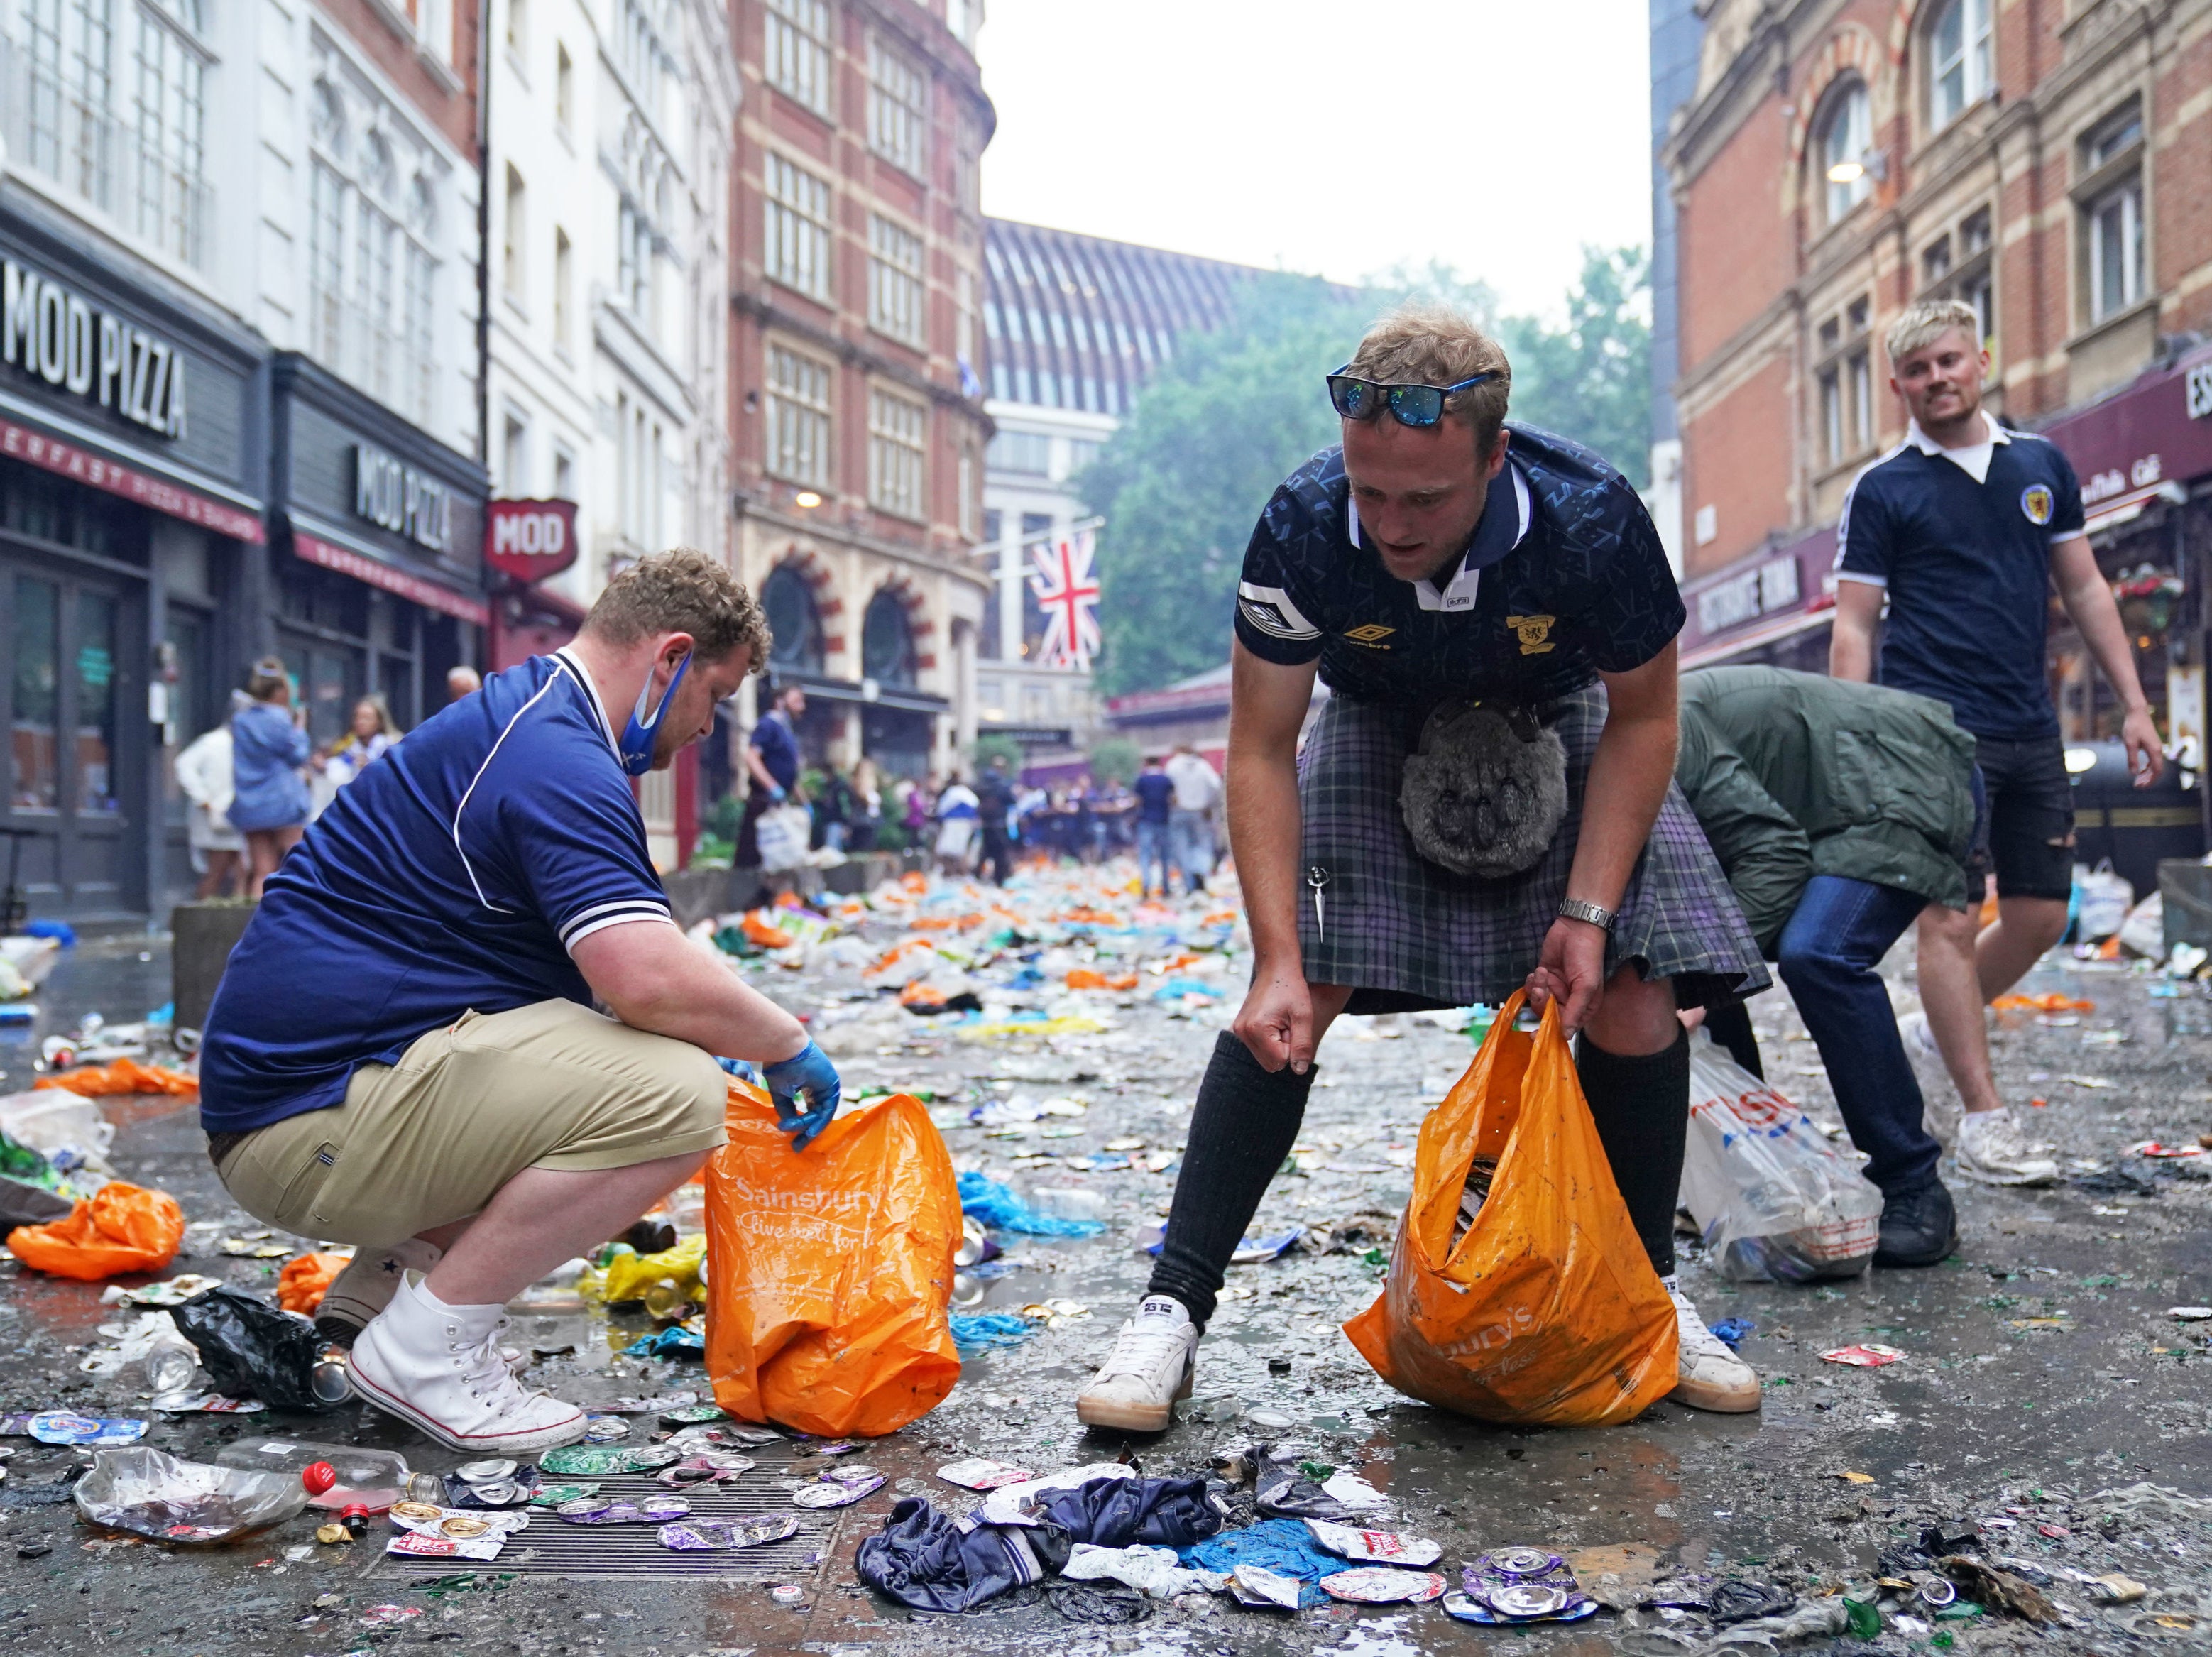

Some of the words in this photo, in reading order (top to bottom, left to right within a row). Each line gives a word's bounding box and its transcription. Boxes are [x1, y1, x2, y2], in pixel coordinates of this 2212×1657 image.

[4, 260, 92, 395] MOD
[99, 313, 187, 440] PIZZA
[356, 442, 402, 532] MOD
[403, 467, 452, 555] PIZZA
[493, 512, 566, 556] MOD
[402, 1535, 449, 1552] STELLA
